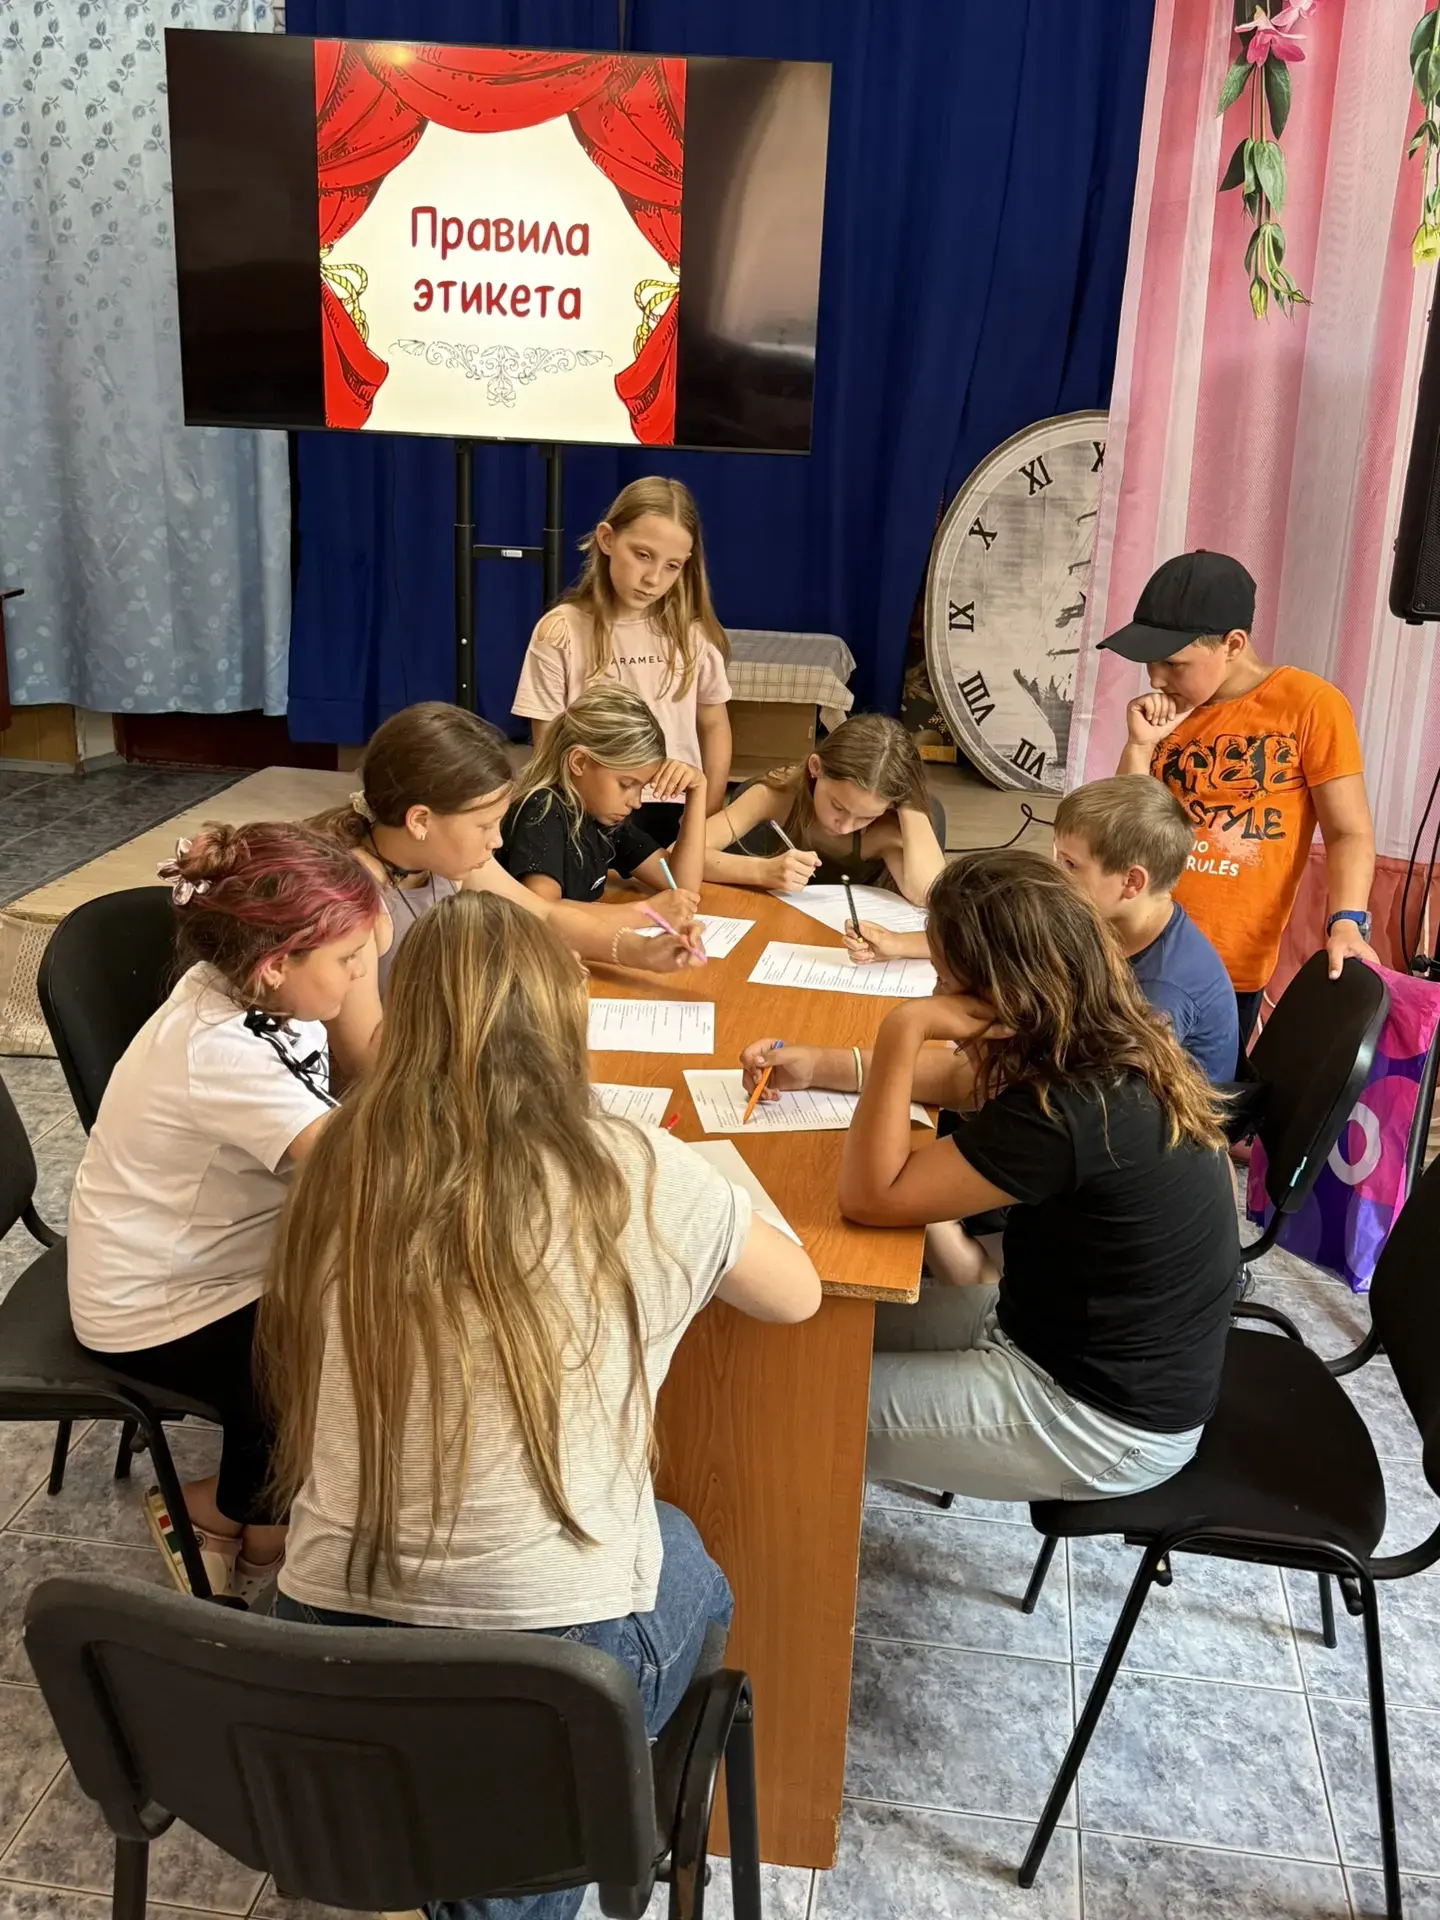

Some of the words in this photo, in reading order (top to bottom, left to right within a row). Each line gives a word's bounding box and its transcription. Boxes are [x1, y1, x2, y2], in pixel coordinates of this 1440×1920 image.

[411, 205, 590, 261] Правила
[413, 278, 582, 321] этикета
[1018, 455, 1053, 496] XI
[968, 517, 998, 550] X
[949, 600, 975, 632] IX
[611, 655, 663, 665] ARAMEL
[958, 670, 996, 726] VIII
[1010, 738, 1046, 780] VII
[1189, 800, 1286, 840] STYLE
[1186, 855, 1240, 877] RULES
